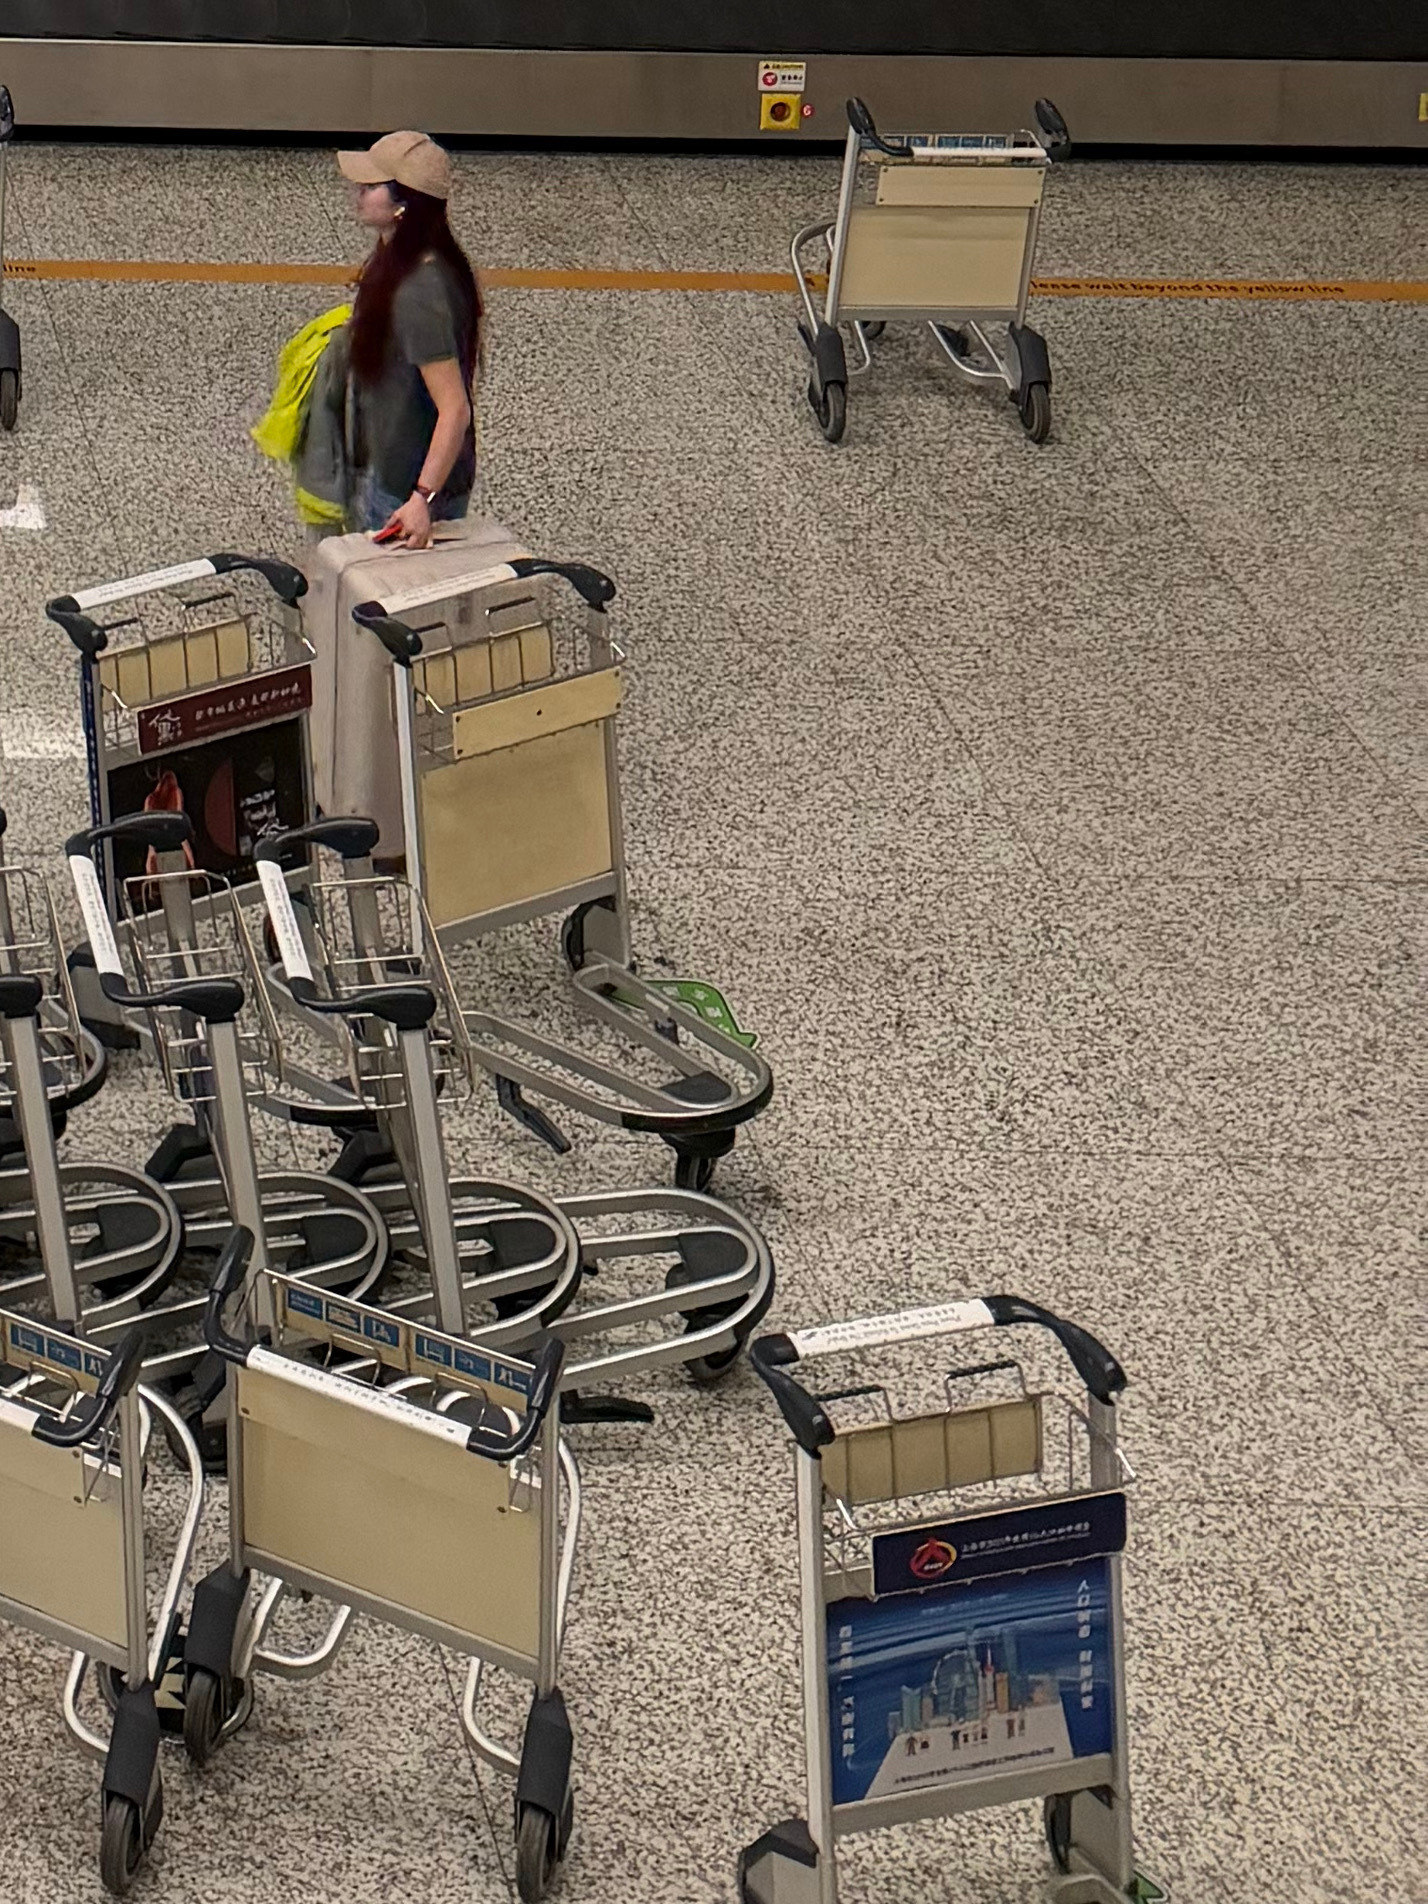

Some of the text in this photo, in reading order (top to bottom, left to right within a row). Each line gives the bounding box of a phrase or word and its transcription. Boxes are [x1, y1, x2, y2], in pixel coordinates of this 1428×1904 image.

[1031, 281, 1346, 295] lease wait beyond the yellow line
